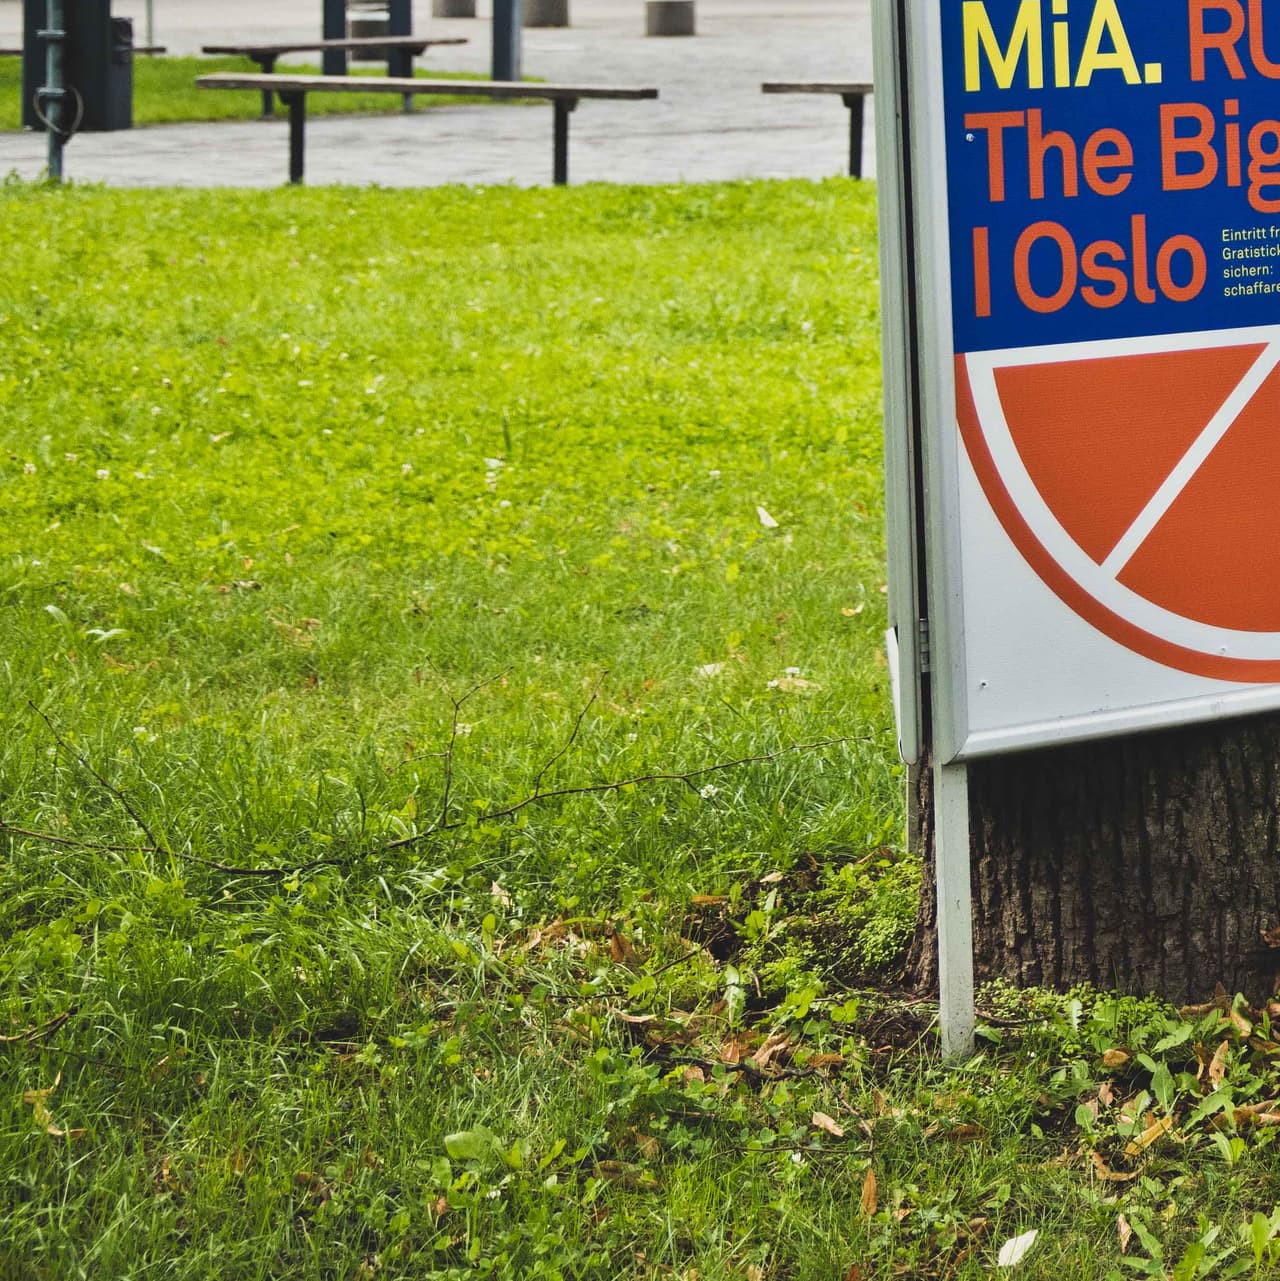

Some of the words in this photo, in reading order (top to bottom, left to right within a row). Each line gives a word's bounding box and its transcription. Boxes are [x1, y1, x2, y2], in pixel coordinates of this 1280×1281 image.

[964, 108, 1134, 203] The
[1222, 227, 1267, 242] Eintritt
[972, 226, 991, 318] I
[1013, 213, 1208, 314] Oslo
[1223, 264, 1274, 278] sichern:
